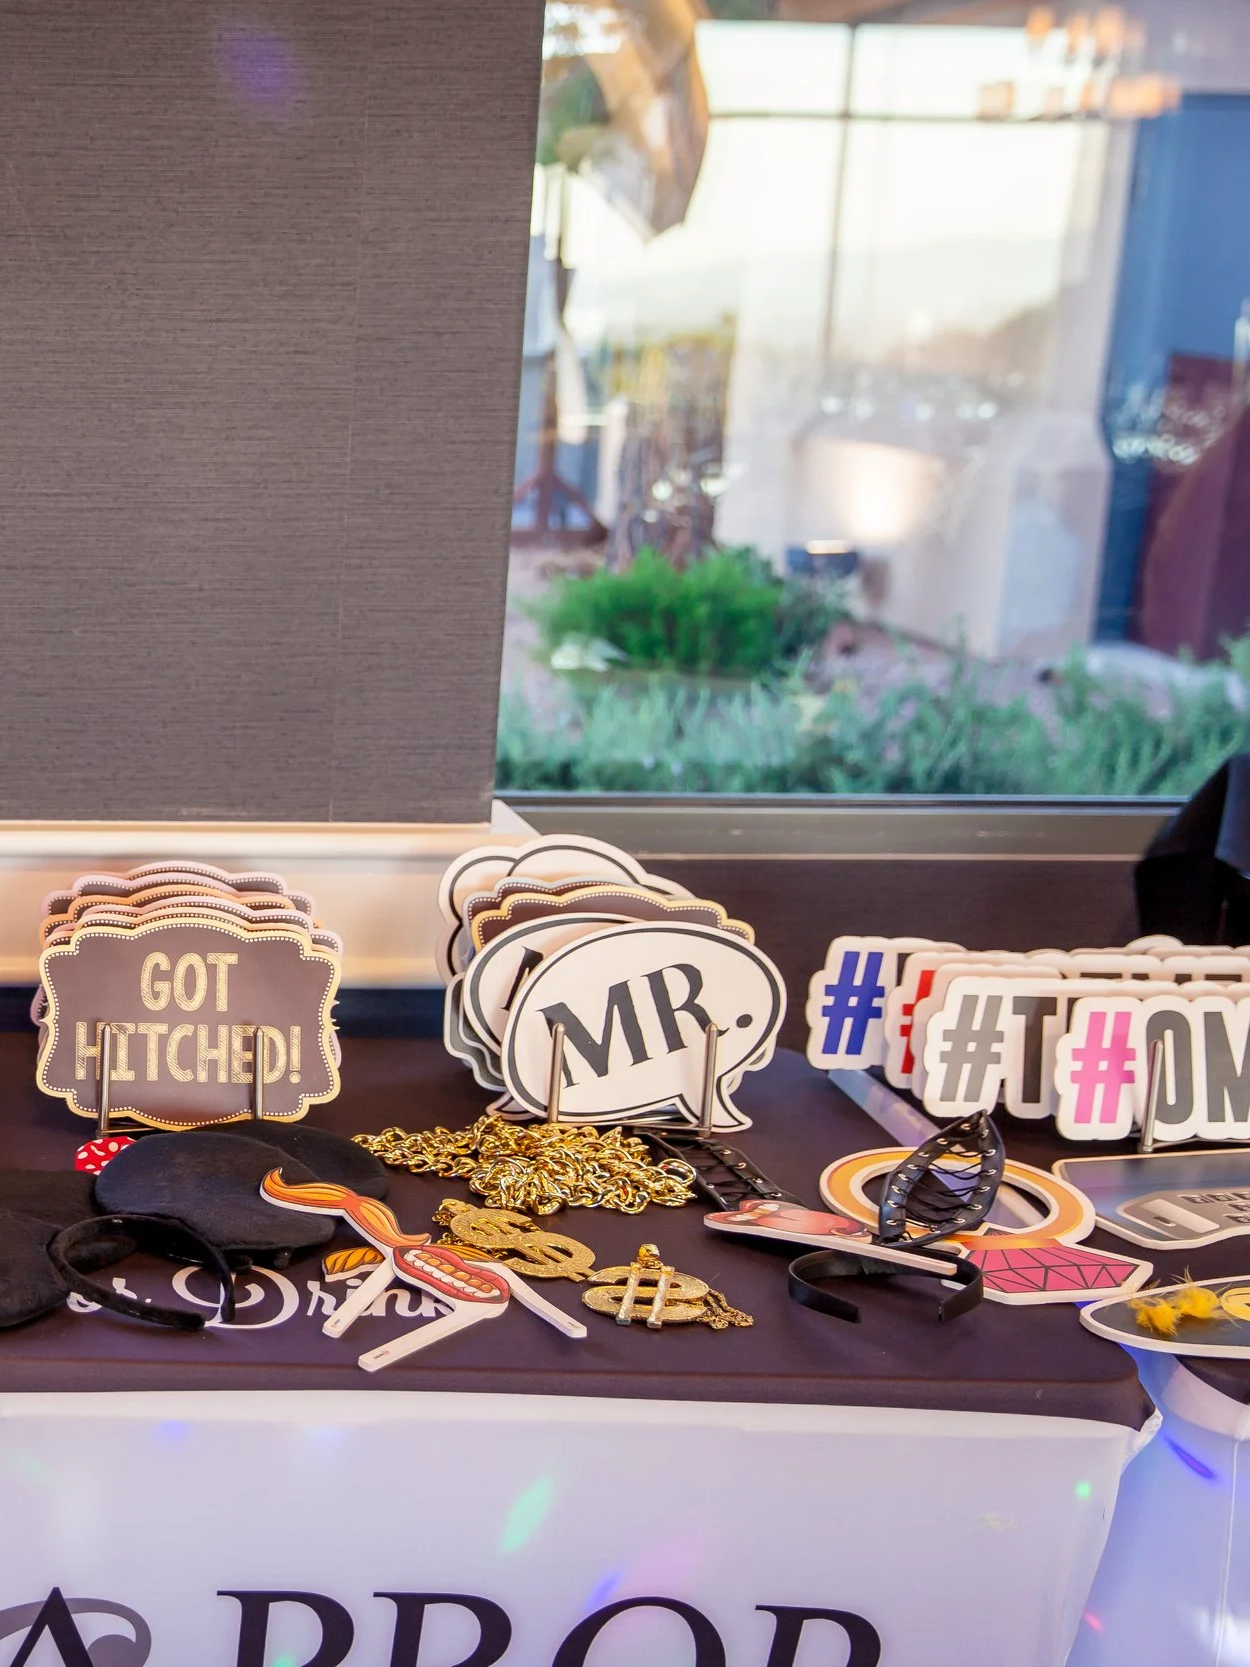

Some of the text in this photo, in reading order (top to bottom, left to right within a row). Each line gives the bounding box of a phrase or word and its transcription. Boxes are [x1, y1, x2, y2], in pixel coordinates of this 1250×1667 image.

[140, 951, 239, 1012] GOT
[74, 1021, 302, 1084] HITCHED!
[535, 963, 753, 1090] MR.
[940, 995, 1082, 1105] #T
